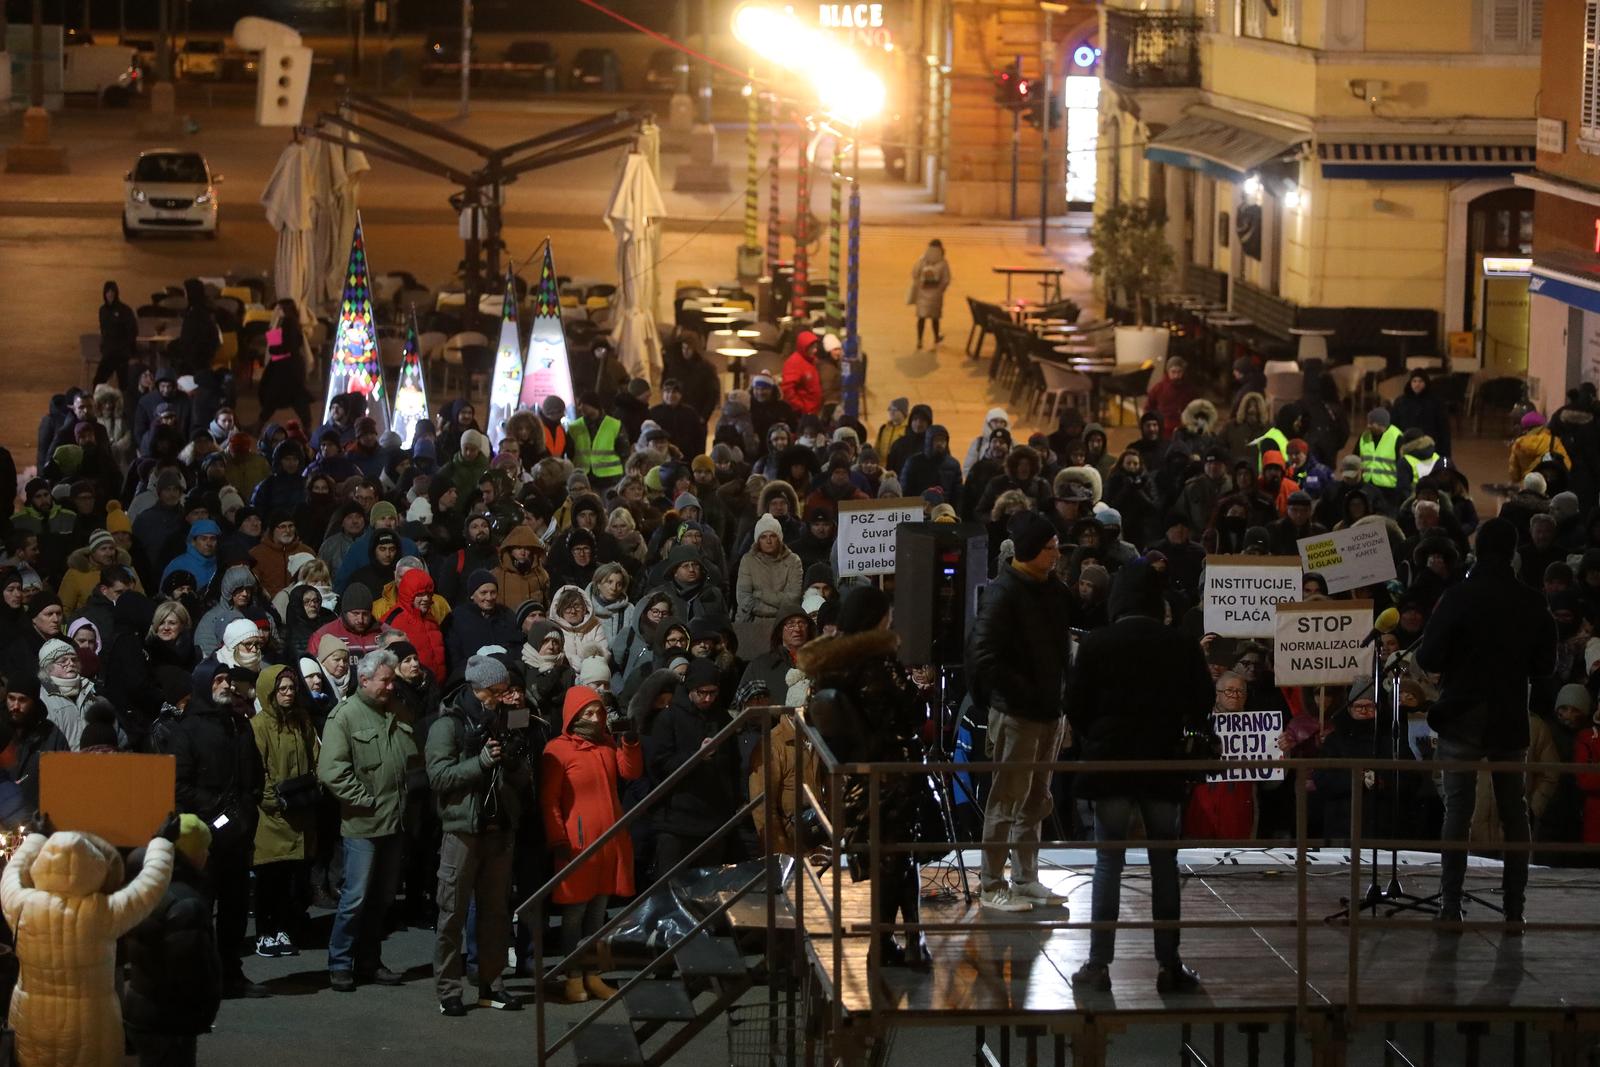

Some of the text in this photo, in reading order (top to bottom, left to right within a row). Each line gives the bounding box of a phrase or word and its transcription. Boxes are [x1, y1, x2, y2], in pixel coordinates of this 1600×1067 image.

[888, 512, 898, 522] di
[901, 512, 912, 523] je
[847, 543, 876, 555] Čuva
[879, 543, 886, 553] li
[847, 558, 895, 572] il galebo
[1211, 578, 1296, 591] INSTITUCIJE,
[1211, 595, 1296, 606] TKO TU KOGA
[1297, 615, 1353, 634] STOP
[1280, 639, 1369, 653] NORMALIZACI
[1291, 655, 1359, 671] NASILJA
[1223, 733, 1266, 754] ICIJI
